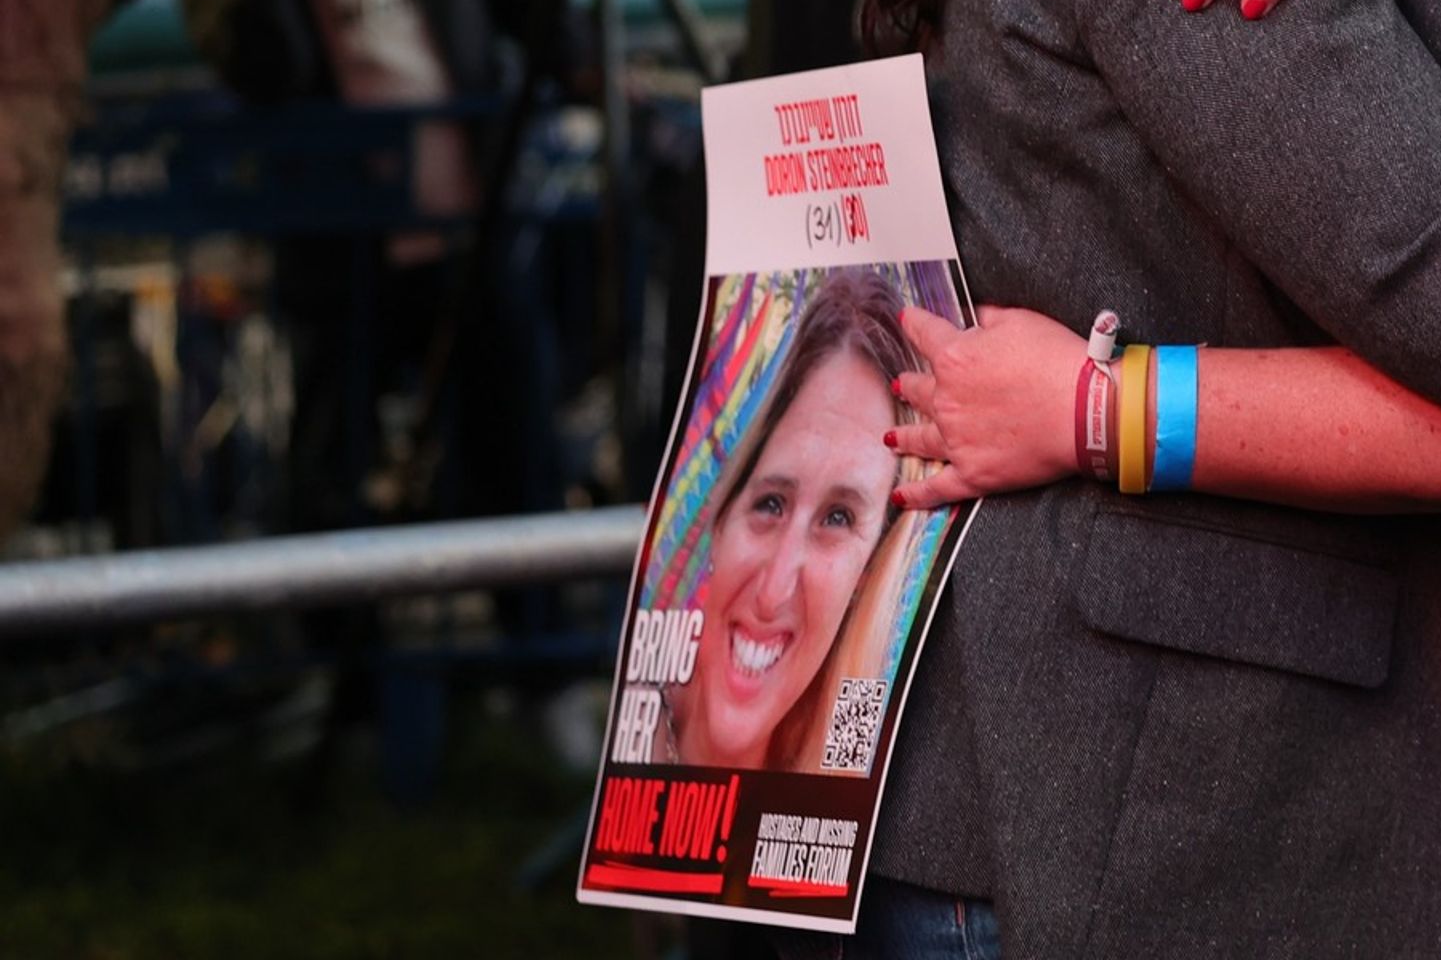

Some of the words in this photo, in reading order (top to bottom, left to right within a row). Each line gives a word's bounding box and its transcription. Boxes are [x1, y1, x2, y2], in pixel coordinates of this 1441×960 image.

[832, 94, 863, 143] דורון
[764, 151, 808, 197] DORON
[806, 142, 889, 191] STEINBRECHER
[805, 200, 842, 249] (31)
[626, 608, 704, 685] BRING
[611, 688, 663, 765] HER
[595, 776, 666, 855] HOME
[659, 773, 740, 863] NOW!
[757, 812, 802, 843] HOSTAGES
[799, 816, 820, 844] AND
[818, 818, 858, 848] MISSING
[751, 839, 808, 882] FAMILIES
[805, 844, 854, 888] FORUM
